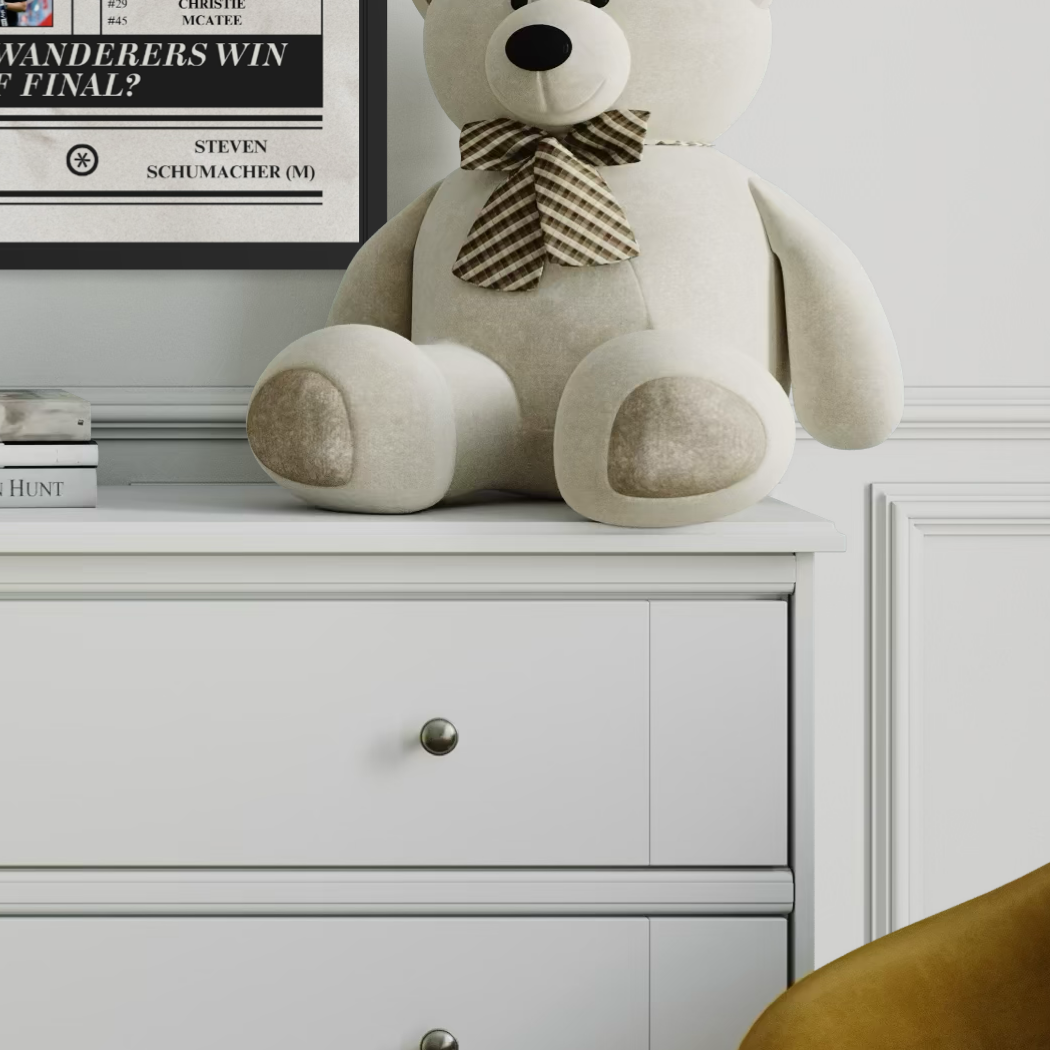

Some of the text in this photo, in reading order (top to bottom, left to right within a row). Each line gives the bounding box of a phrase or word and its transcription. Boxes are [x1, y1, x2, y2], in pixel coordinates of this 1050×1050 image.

[107, 15, 242, 26] #45 MCATEE
[216, 43, 288, 66] WIN
[20, 73, 141, 96] FINAL?
[195, 140, 267, 153] STEVEN
[147, 165, 315, 181] SCHUMACHER (M)
